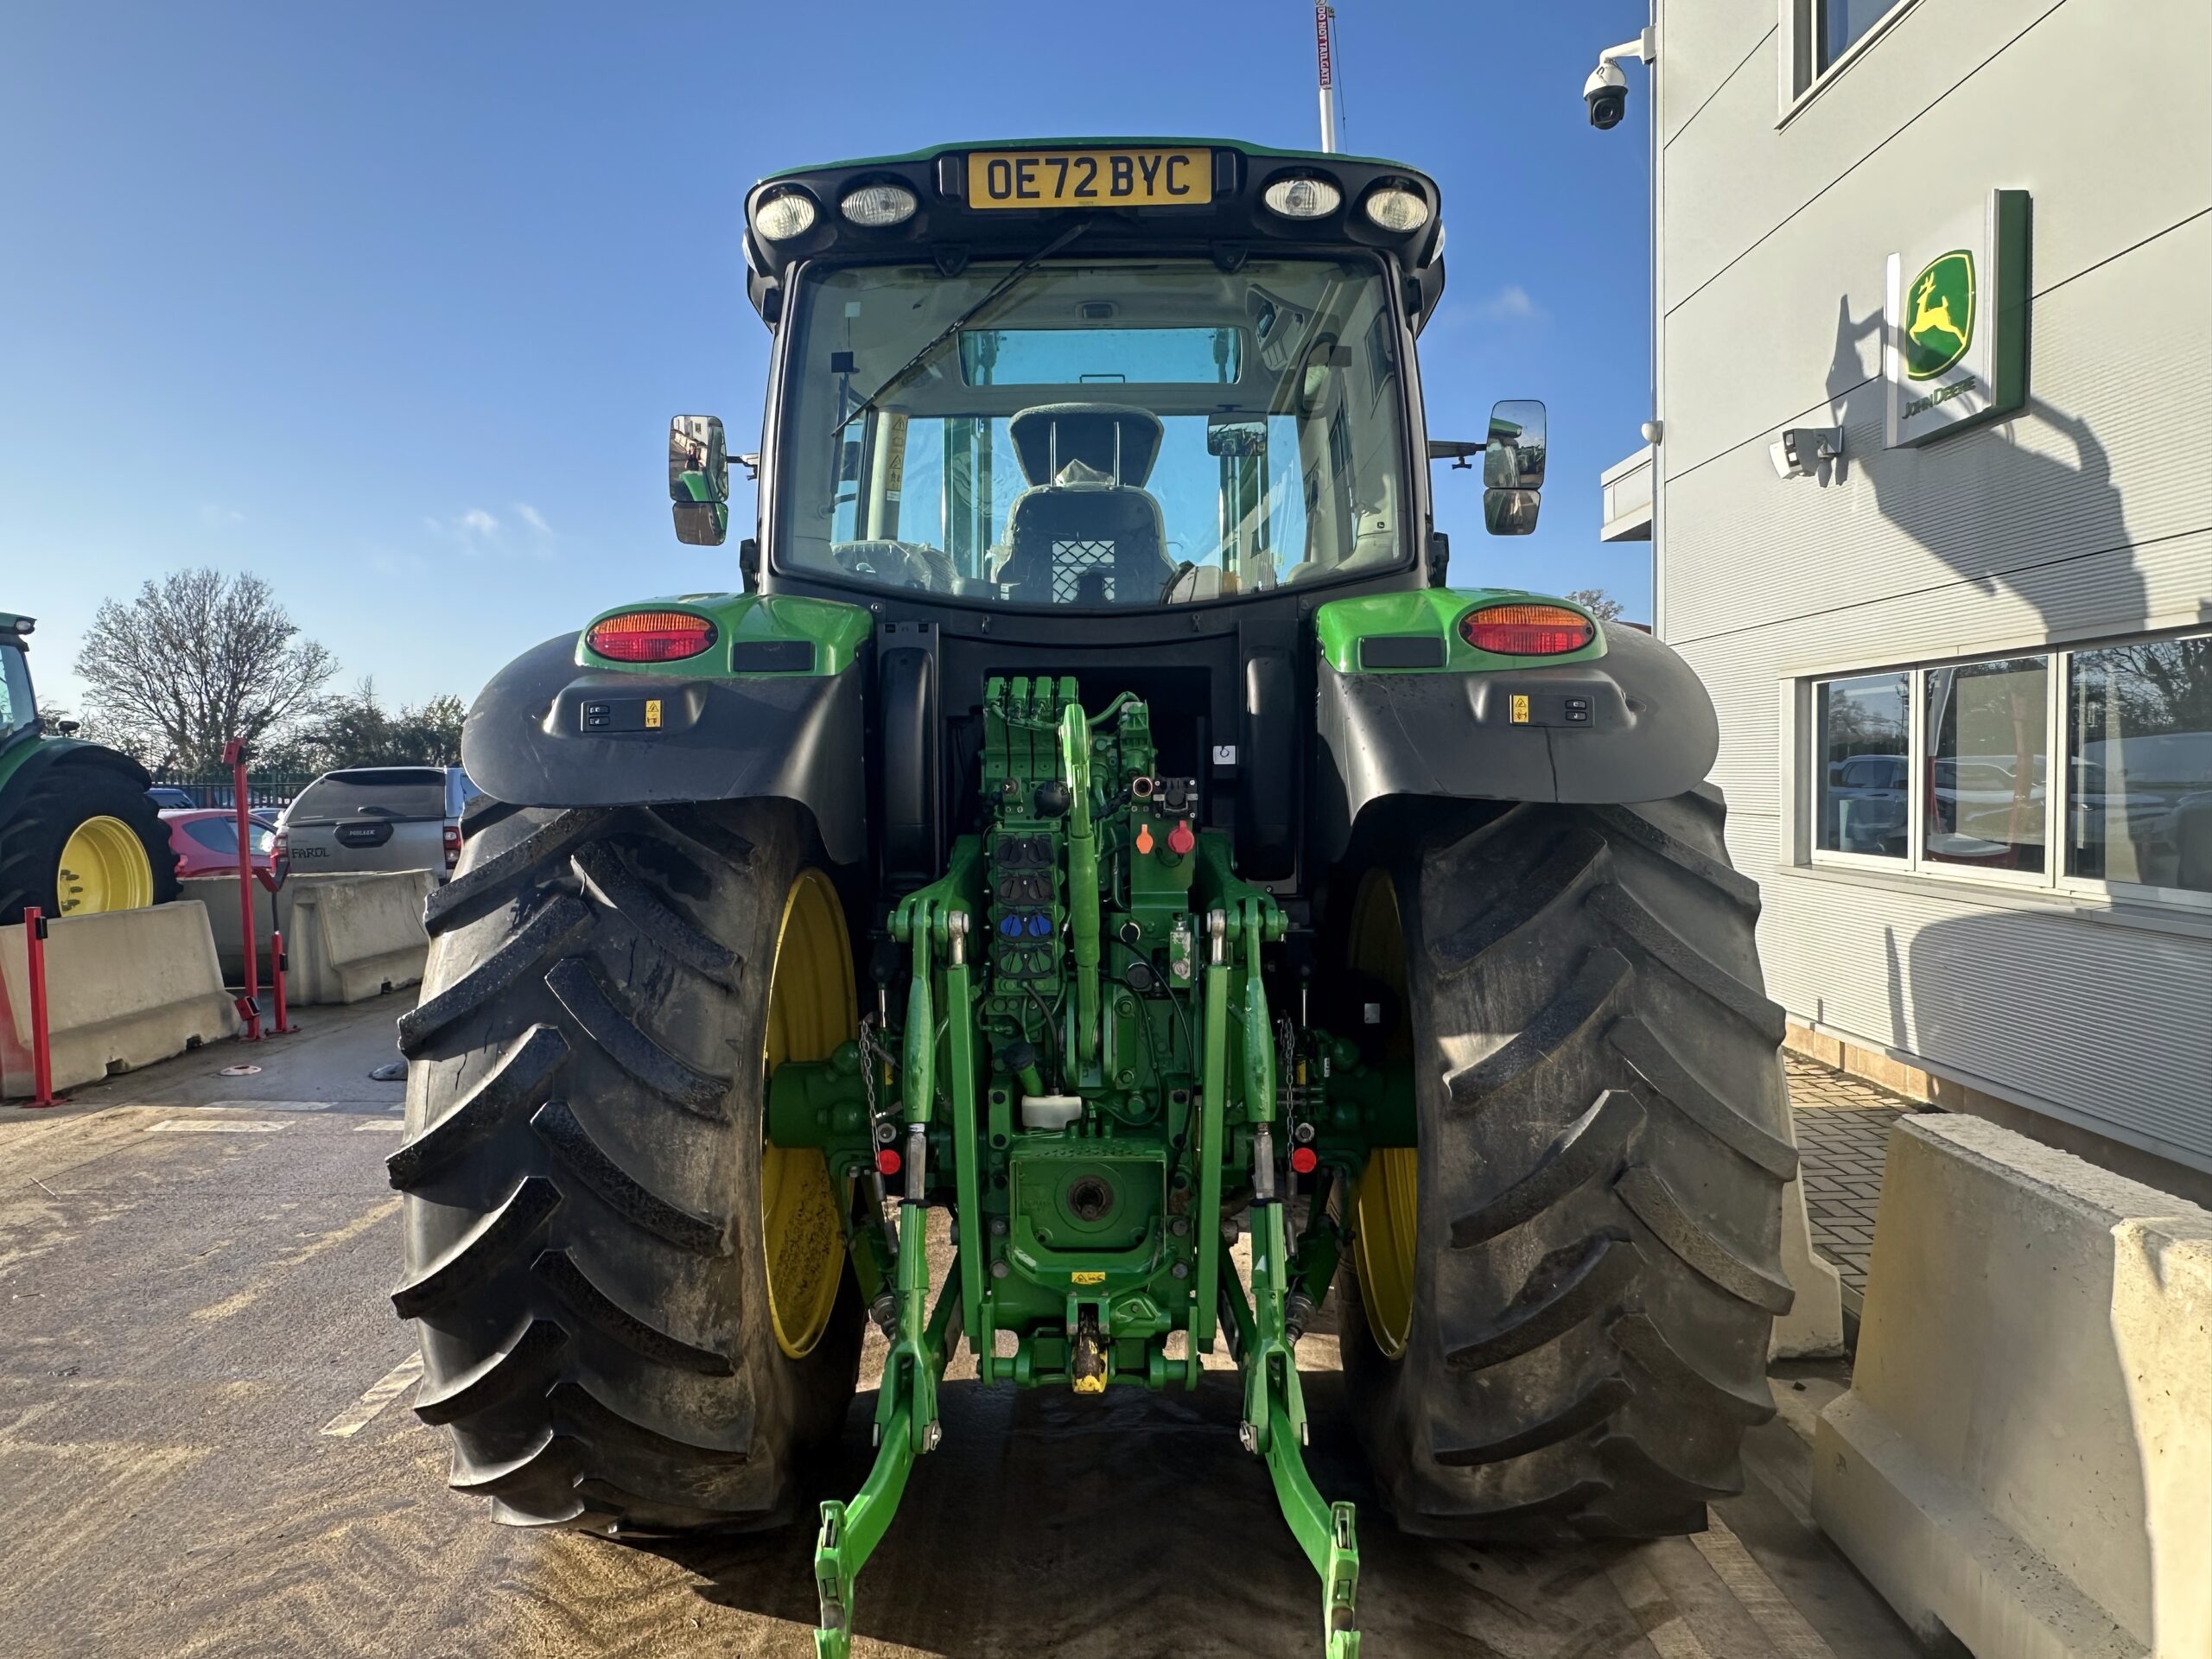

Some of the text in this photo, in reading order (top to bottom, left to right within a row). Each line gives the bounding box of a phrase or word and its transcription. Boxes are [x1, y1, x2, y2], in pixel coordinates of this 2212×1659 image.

[1317, 6, 1330, 85] DO NOT TAILGATE
[987, 155, 1191, 200] OE72 BYC
[1902, 375, 1976, 419] JOHN DEERE
[291, 848, 331, 858] FAROL
